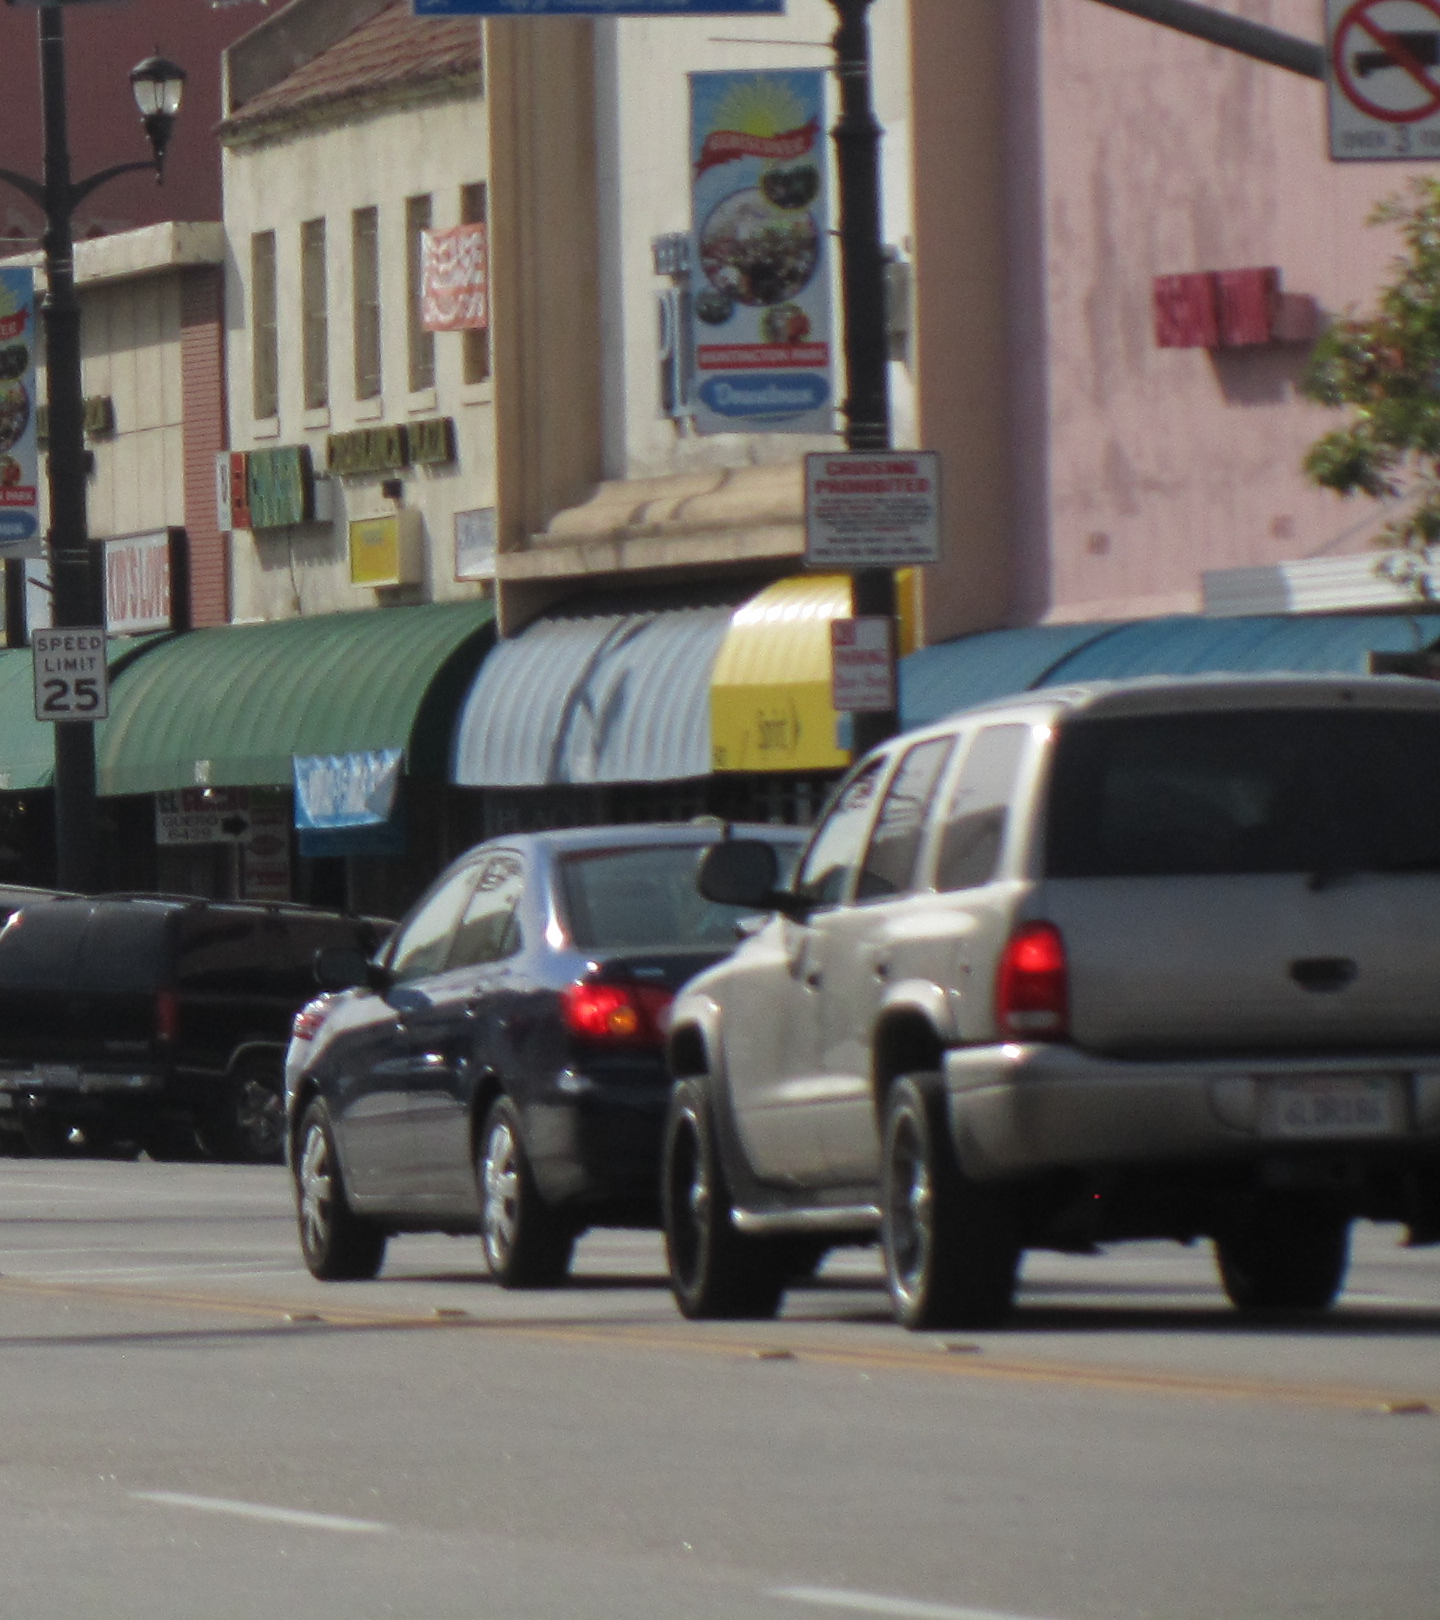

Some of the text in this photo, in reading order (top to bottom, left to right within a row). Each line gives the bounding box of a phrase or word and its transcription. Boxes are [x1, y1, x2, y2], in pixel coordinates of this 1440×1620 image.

[37, 636, 102, 652] SPEED
[44, 656, 97, 673] LIMIT
[42, 678, 101, 713] 25
